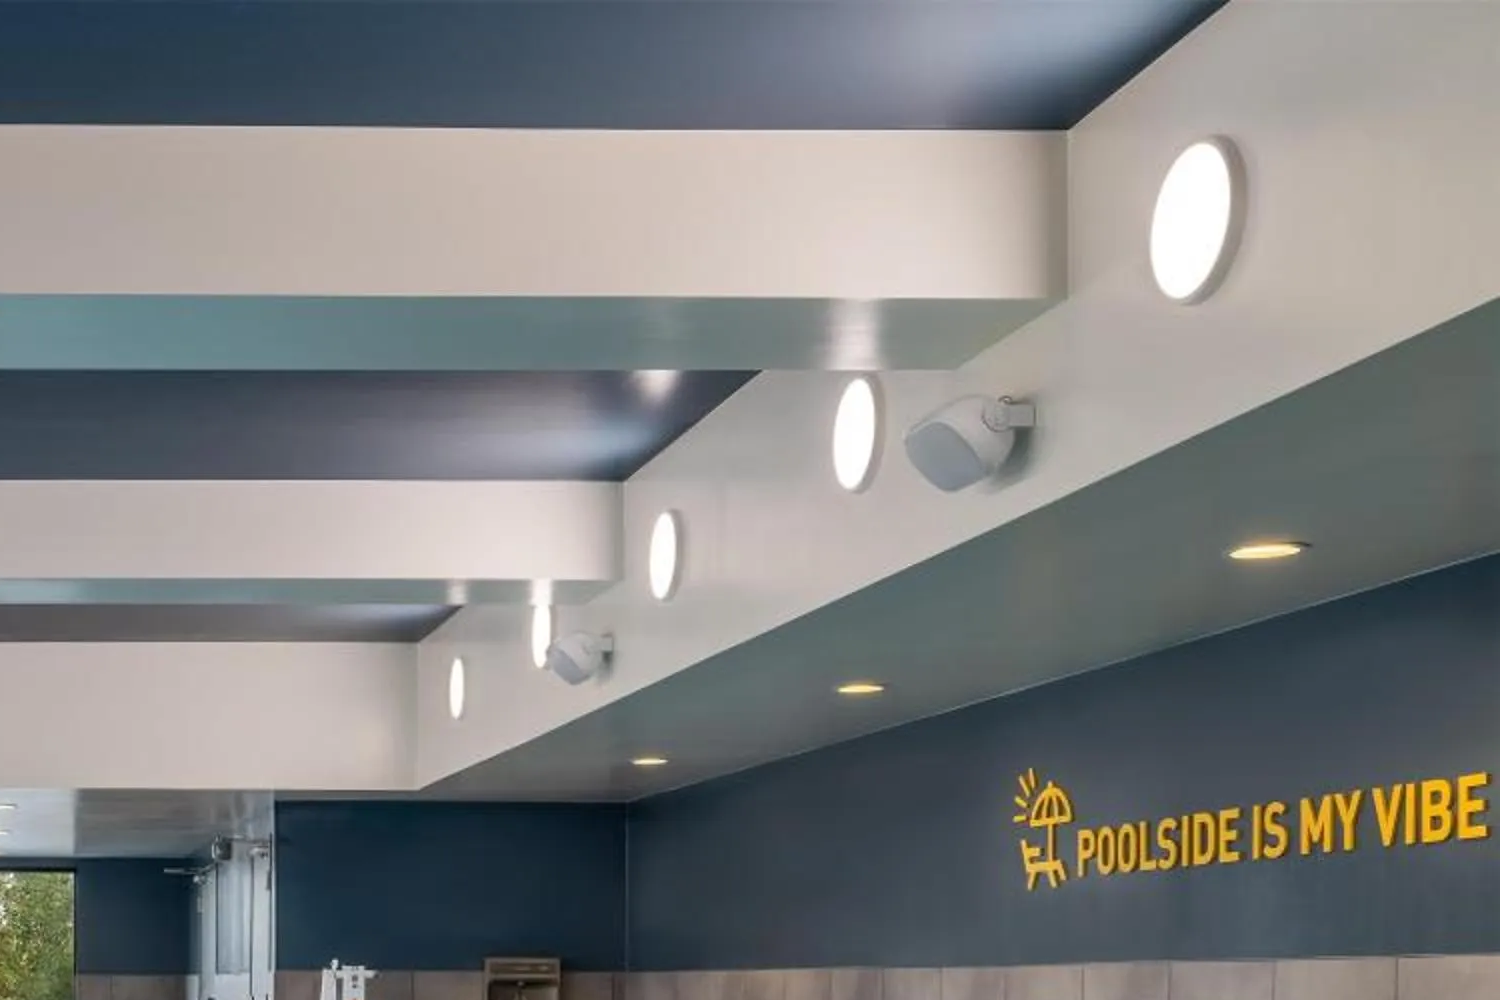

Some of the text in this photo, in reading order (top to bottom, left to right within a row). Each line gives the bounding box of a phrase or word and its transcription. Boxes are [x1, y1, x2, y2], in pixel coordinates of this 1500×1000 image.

[1076, 770, 1490, 877] POOLSIDE IS MY VIBE
